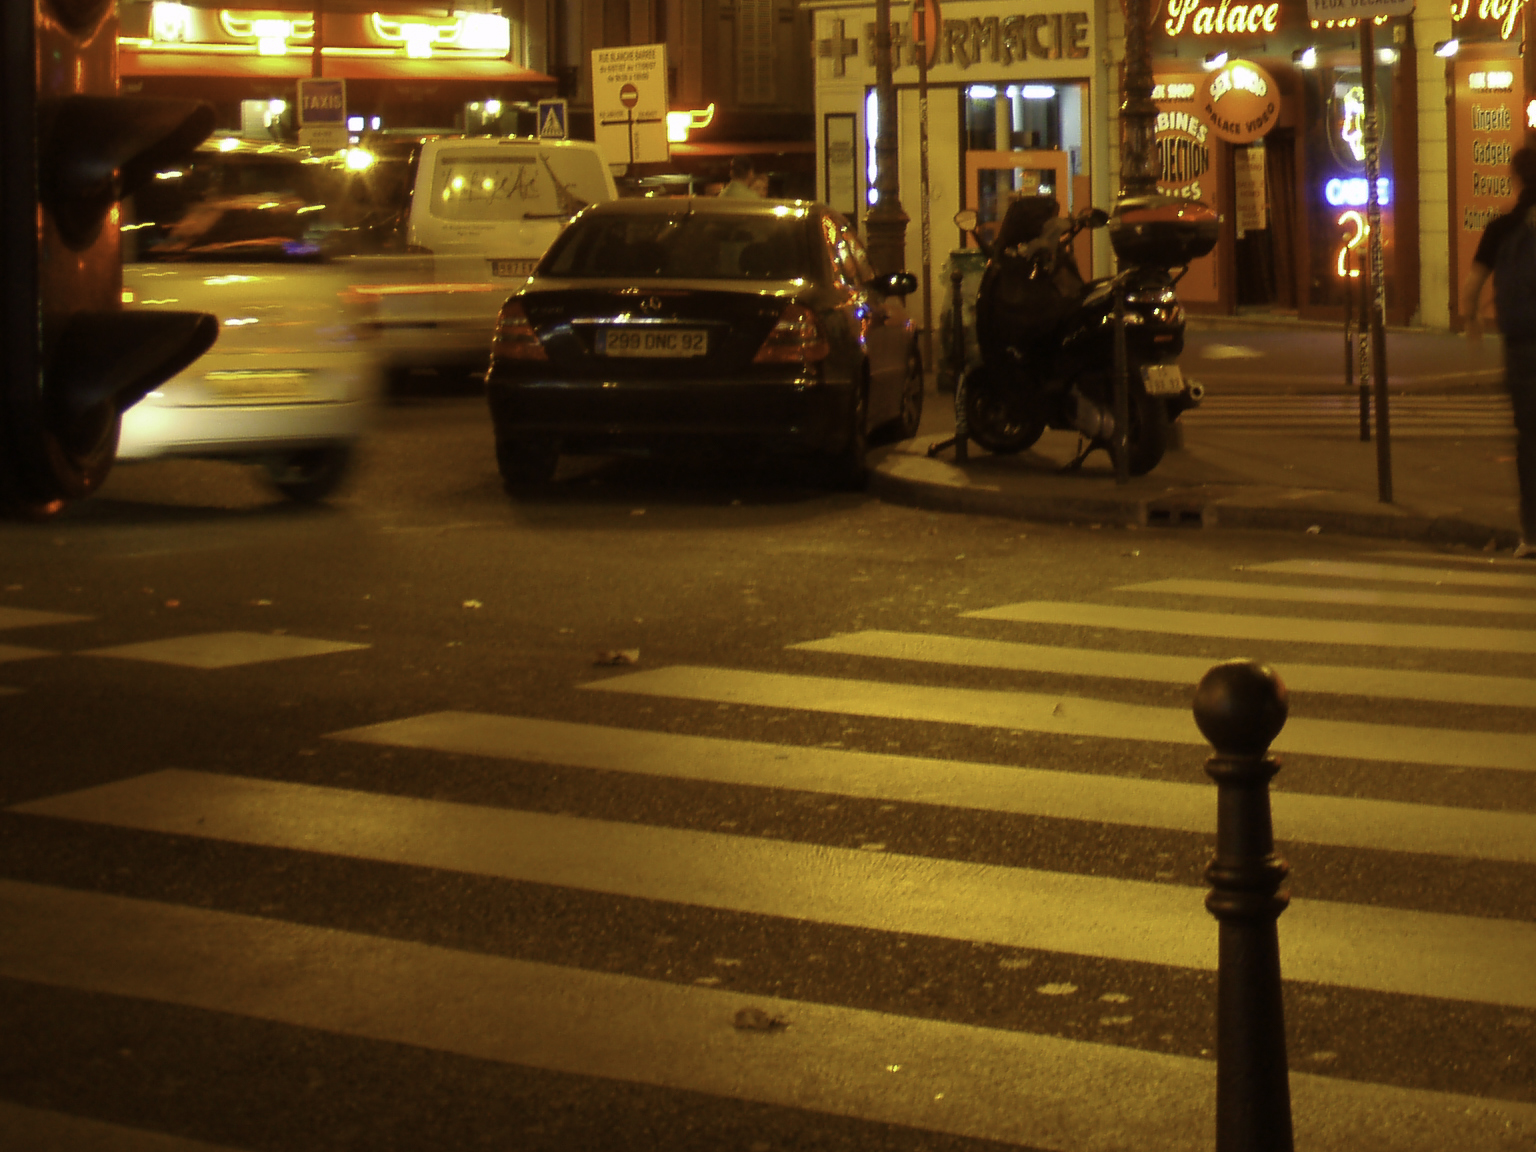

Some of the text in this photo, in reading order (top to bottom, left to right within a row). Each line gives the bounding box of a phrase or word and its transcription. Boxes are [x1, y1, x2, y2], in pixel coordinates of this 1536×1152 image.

[302, 95, 342, 109] TAXIS
[1155, 110, 1208, 143] BINES
[1205, 102, 1275, 135] PALACE VIDEO
[1472, 103, 1512, 133] Lingerie
[1473, 139, 1512, 167] Gadgets
[1473, 170, 1512, 197] Revues
[608, 334, 704, 349] 299 DNC 92
